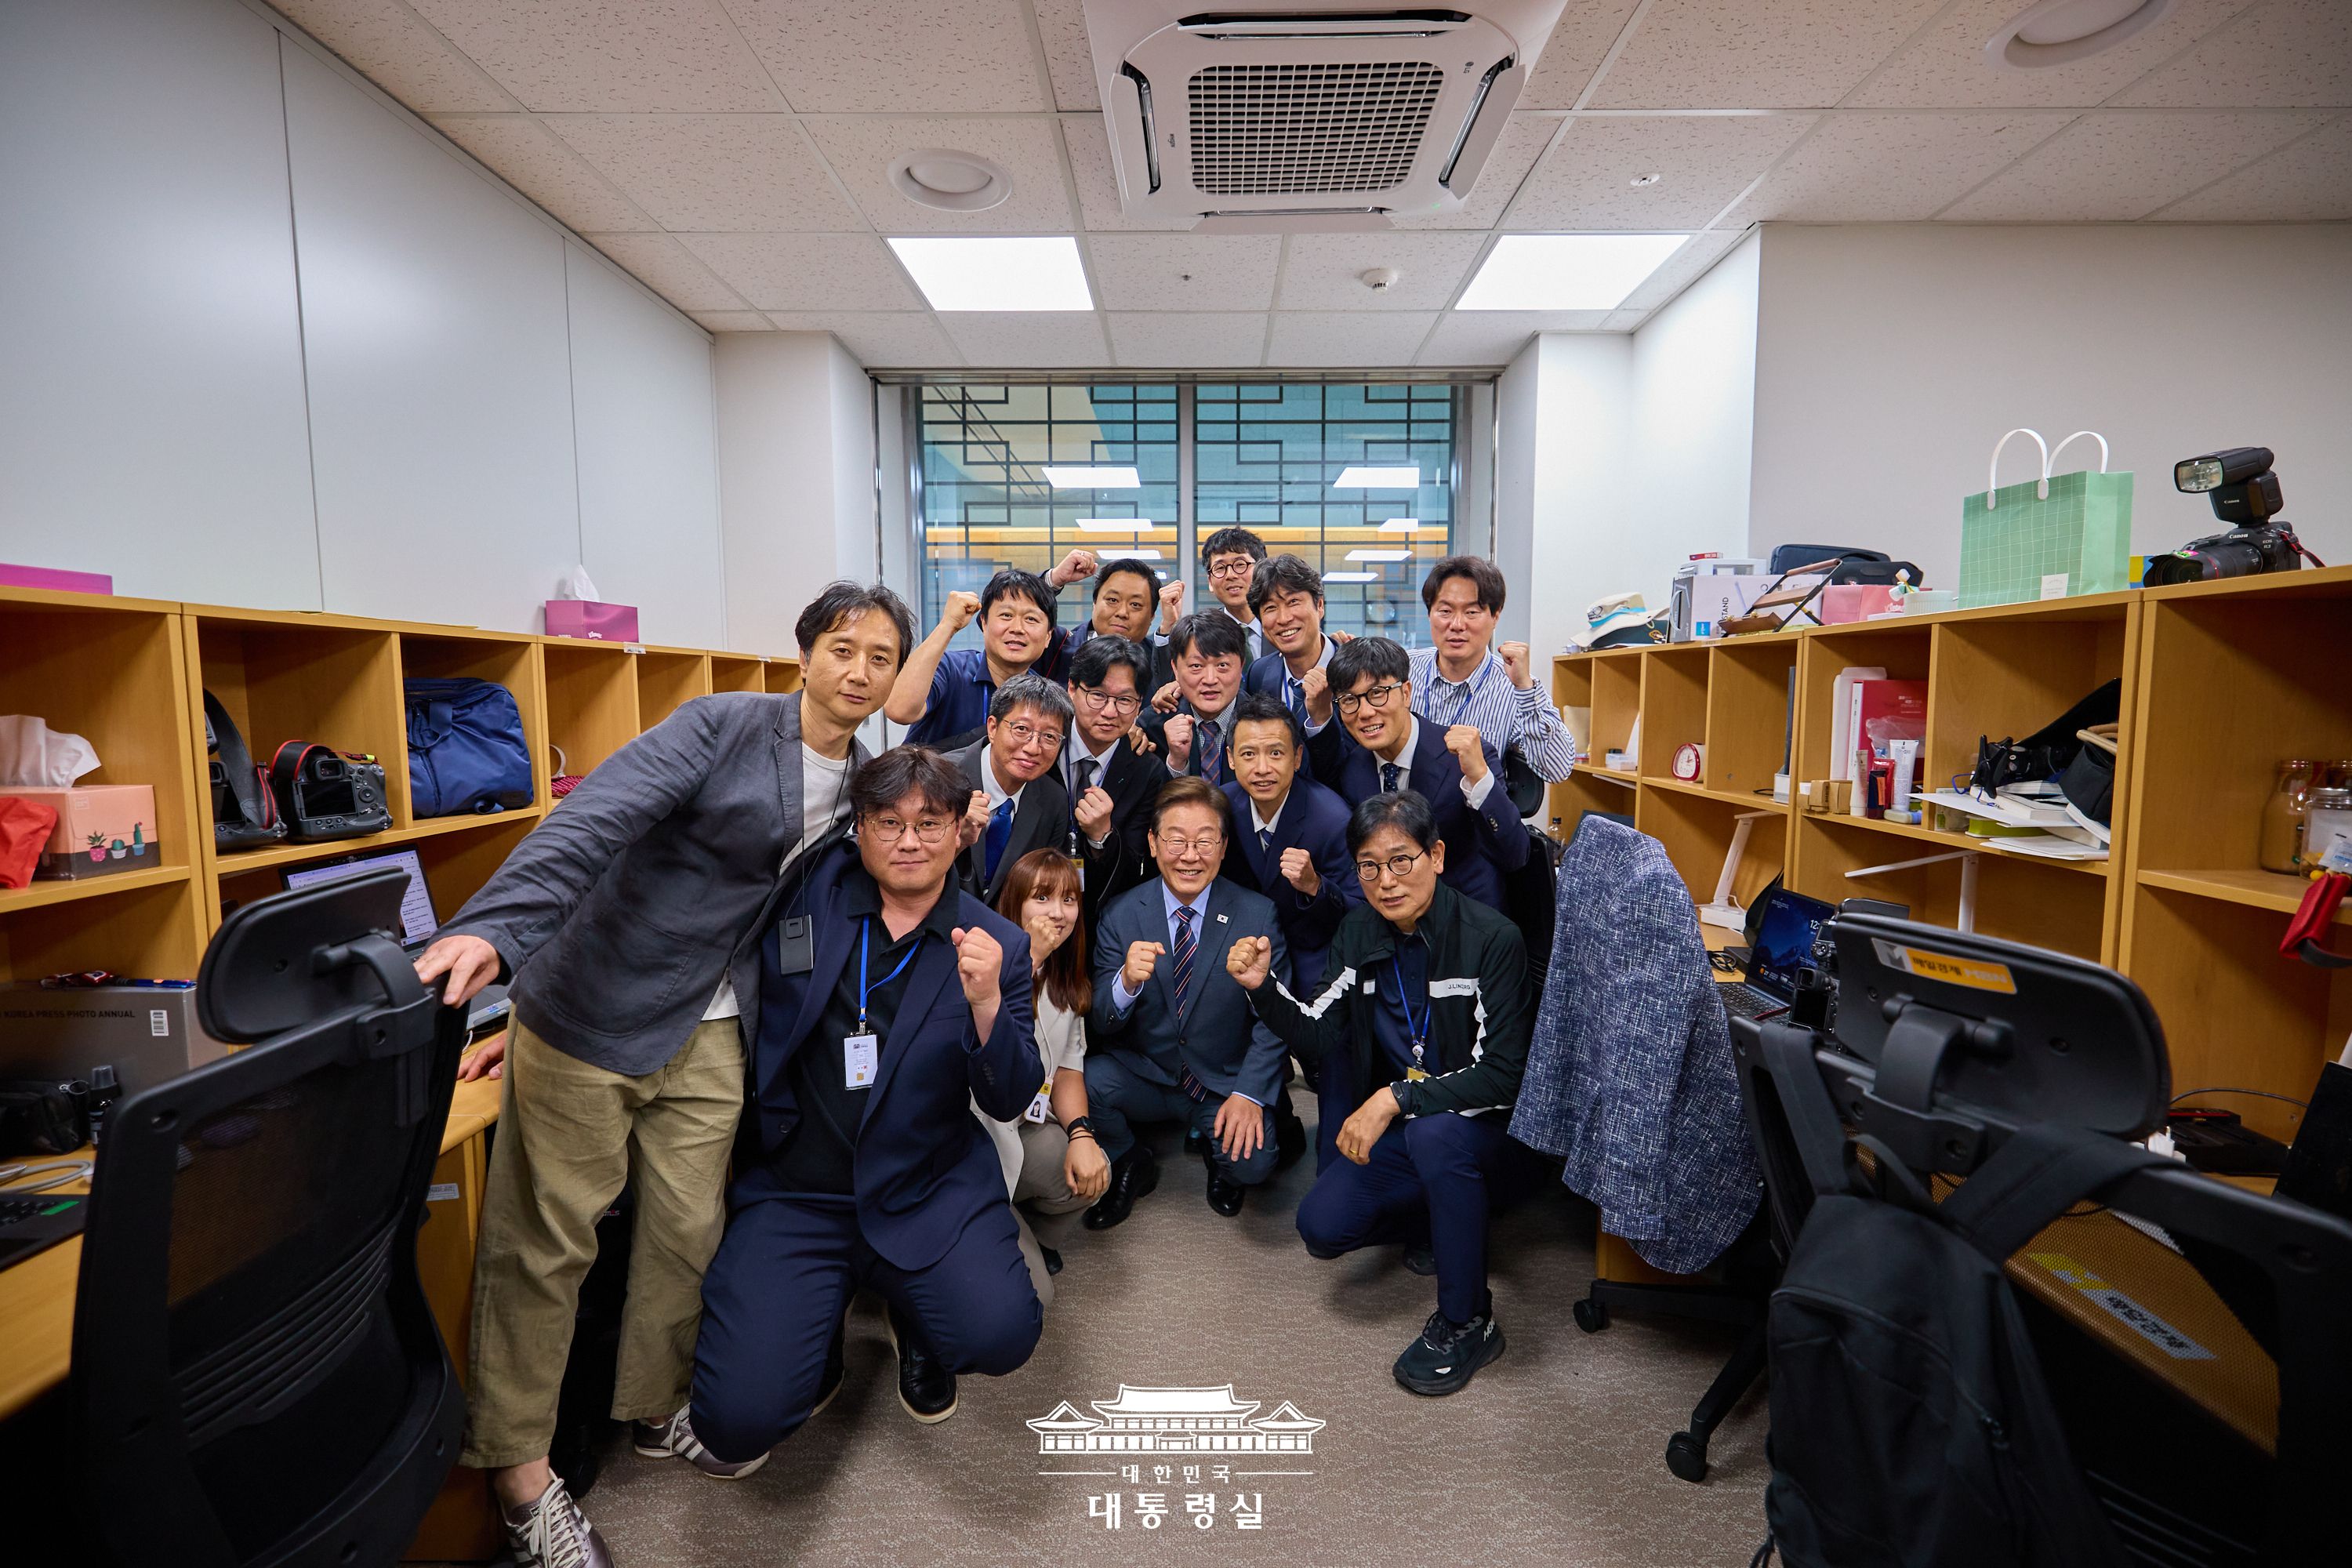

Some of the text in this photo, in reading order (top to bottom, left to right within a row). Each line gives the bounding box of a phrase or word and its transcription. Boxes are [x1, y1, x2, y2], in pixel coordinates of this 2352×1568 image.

[1912, 956, 1962, 976] 매일경제
[4, 1010, 136, 1018] KOREA PRESS PHOTO ANNUAL
